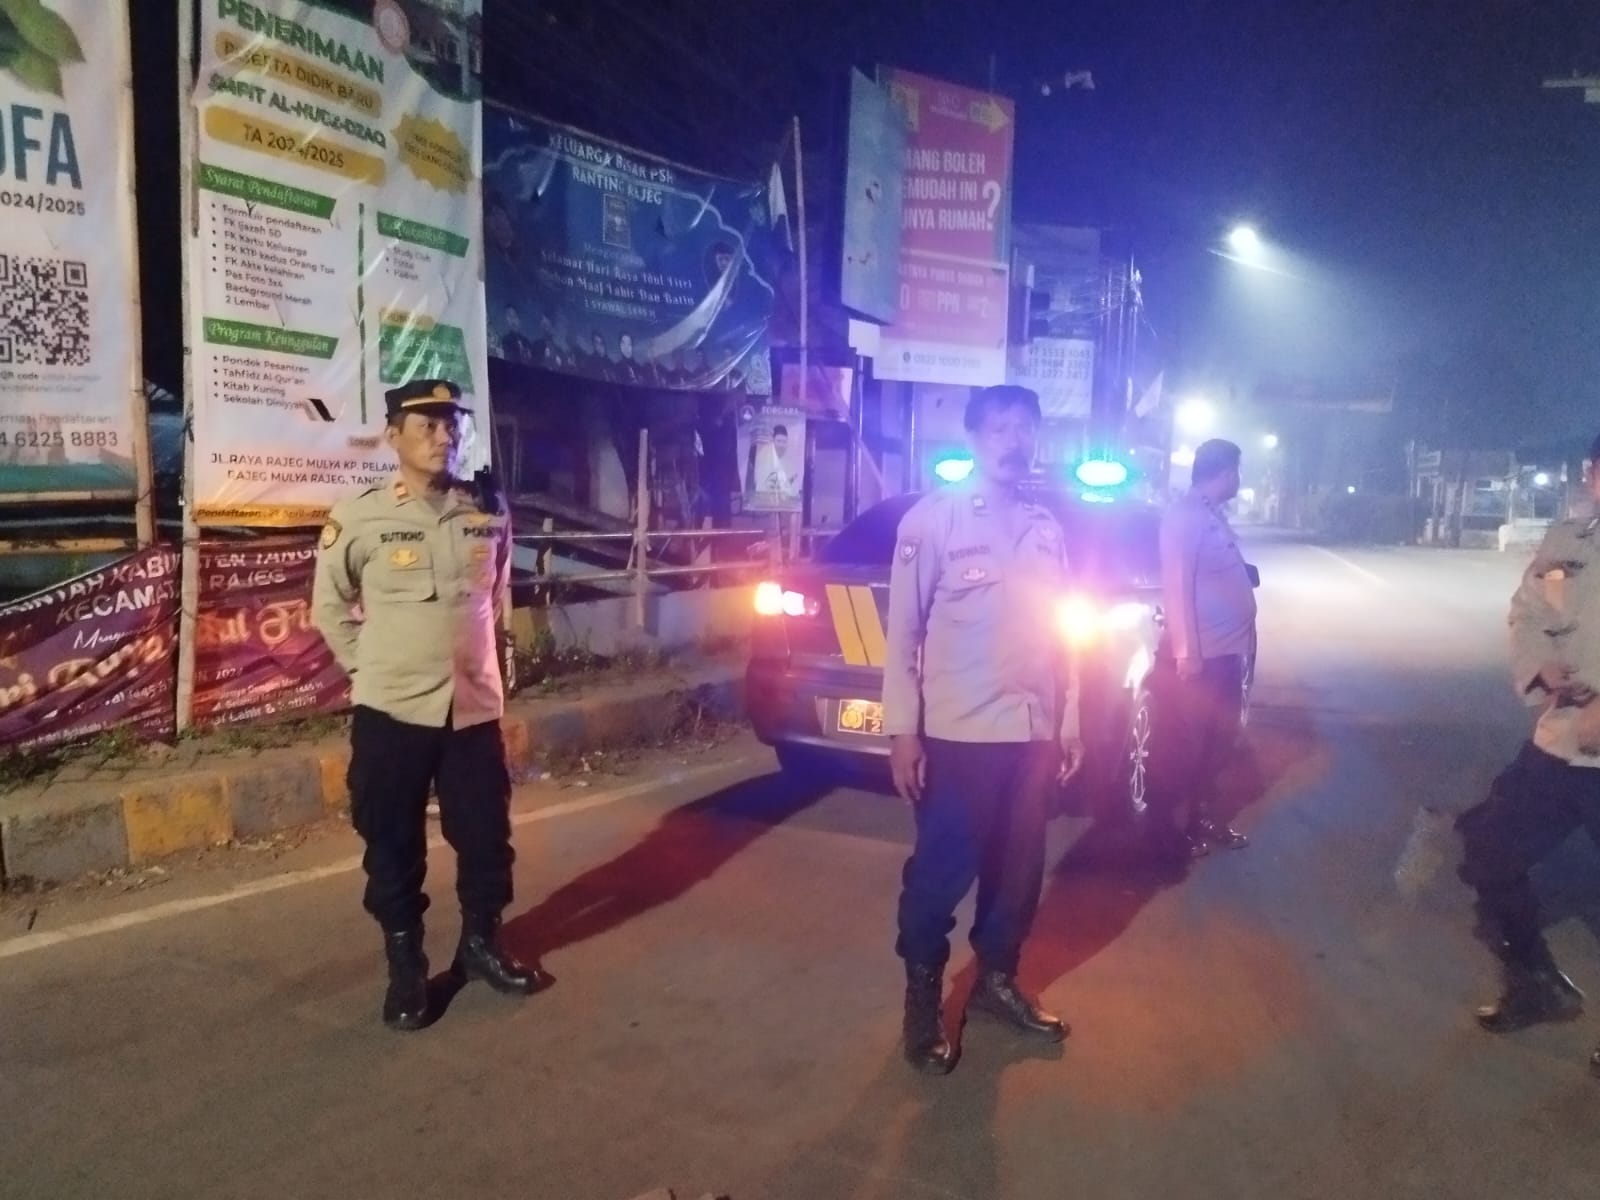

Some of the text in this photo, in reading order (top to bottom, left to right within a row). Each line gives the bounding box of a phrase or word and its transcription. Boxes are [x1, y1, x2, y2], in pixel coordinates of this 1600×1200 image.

[218, 0, 385, 83] PENERIMAAN
[243, 123, 262, 145] TA
[944, 150, 986, 174] BOLEH
[233, 296, 270, 311] Lembar
[208, 321, 330, 353] Program Keunggulan
[222, 355, 260, 368] Pondok
[15, 431, 65, 447] 6225
[71, 432, 119, 447] 8883
[266, 456, 303, 468] RAJEG
[306, 460, 340, 470] MULYA
[271, 472, 307, 483] MULYA
